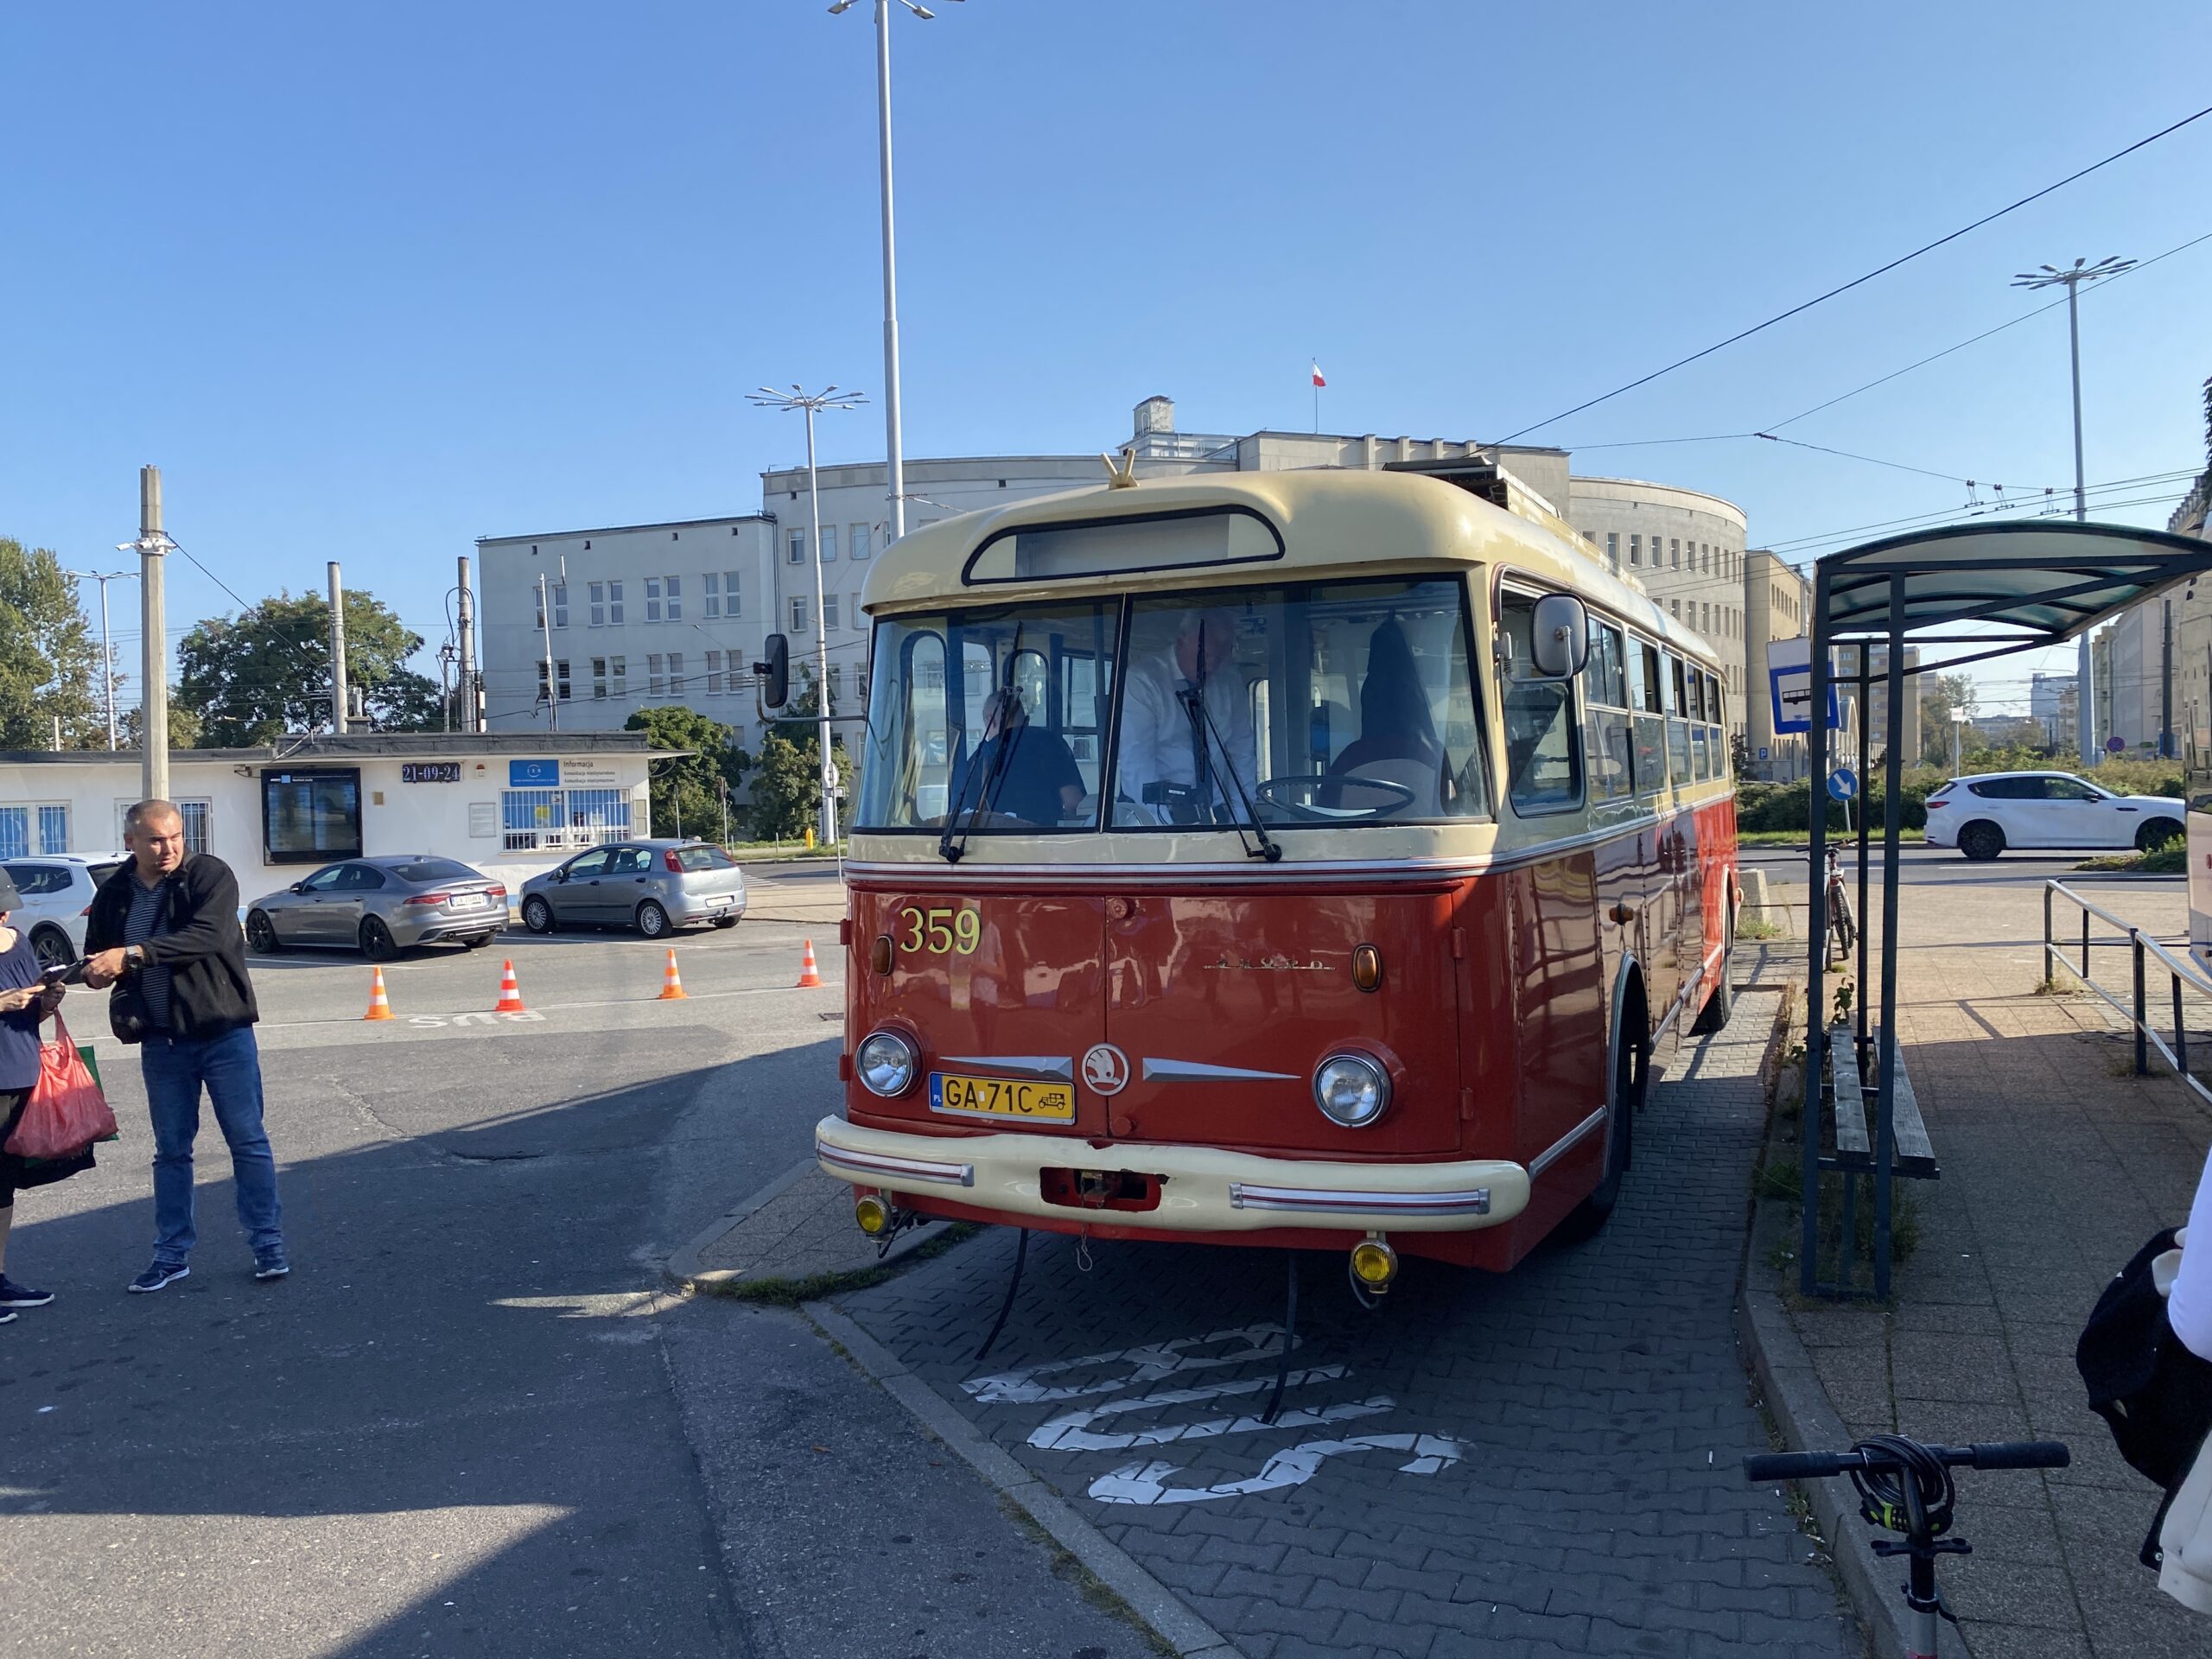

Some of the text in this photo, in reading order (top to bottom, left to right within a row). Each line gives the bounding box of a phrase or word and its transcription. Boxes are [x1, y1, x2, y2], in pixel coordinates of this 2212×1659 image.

[403, 766, 460, 781] 21-09-24
[563, 760, 594, 769] Informacja
[900, 906, 981, 955] 359
[408, 1010, 546, 1028] BUS
[933, 1094, 942, 1103] PL
[946, 1079, 1033, 1113] GA 71C
[958, 1321, 1477, 1504] BUS
